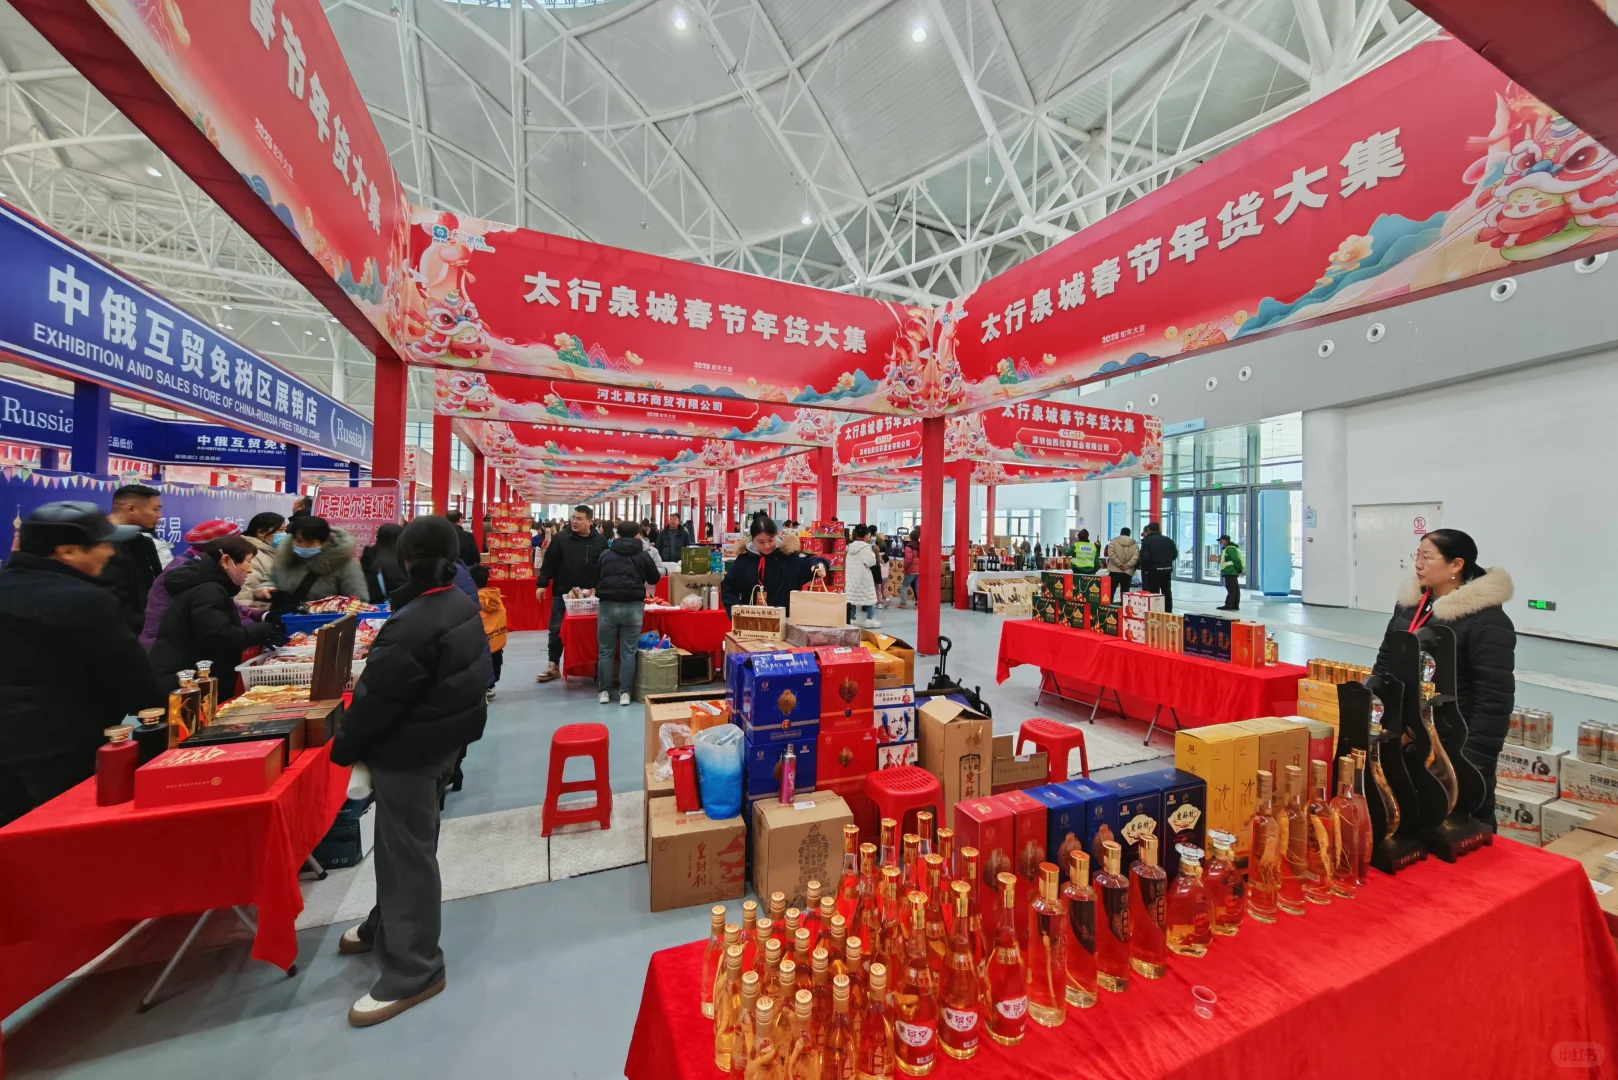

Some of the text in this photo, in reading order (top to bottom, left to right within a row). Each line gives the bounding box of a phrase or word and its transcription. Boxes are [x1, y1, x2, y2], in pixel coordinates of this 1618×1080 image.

[981, 126, 1407, 345] 太行泉城春节年货大集
[523, 271, 868, 355] 太行泉城春节年货大集
[49, 263, 317, 427] 中俄互贸免税区展销店
[1102, 332, 1120, 344] 2025
[34, 323, 321, 442] EXHIBITION AND SALES STORE OF CHINA-RUSSIA FREE TRADE ZONE
[693, 361, 711, 370] 2025
[2, 395, 73, 433] Russia
[1002, 402, 1135, 434] 太行泉城春节年货大集
[336, 417, 363, 450] Russia
[317, 493, 395, 520] 正宗哈尔滨红肠
